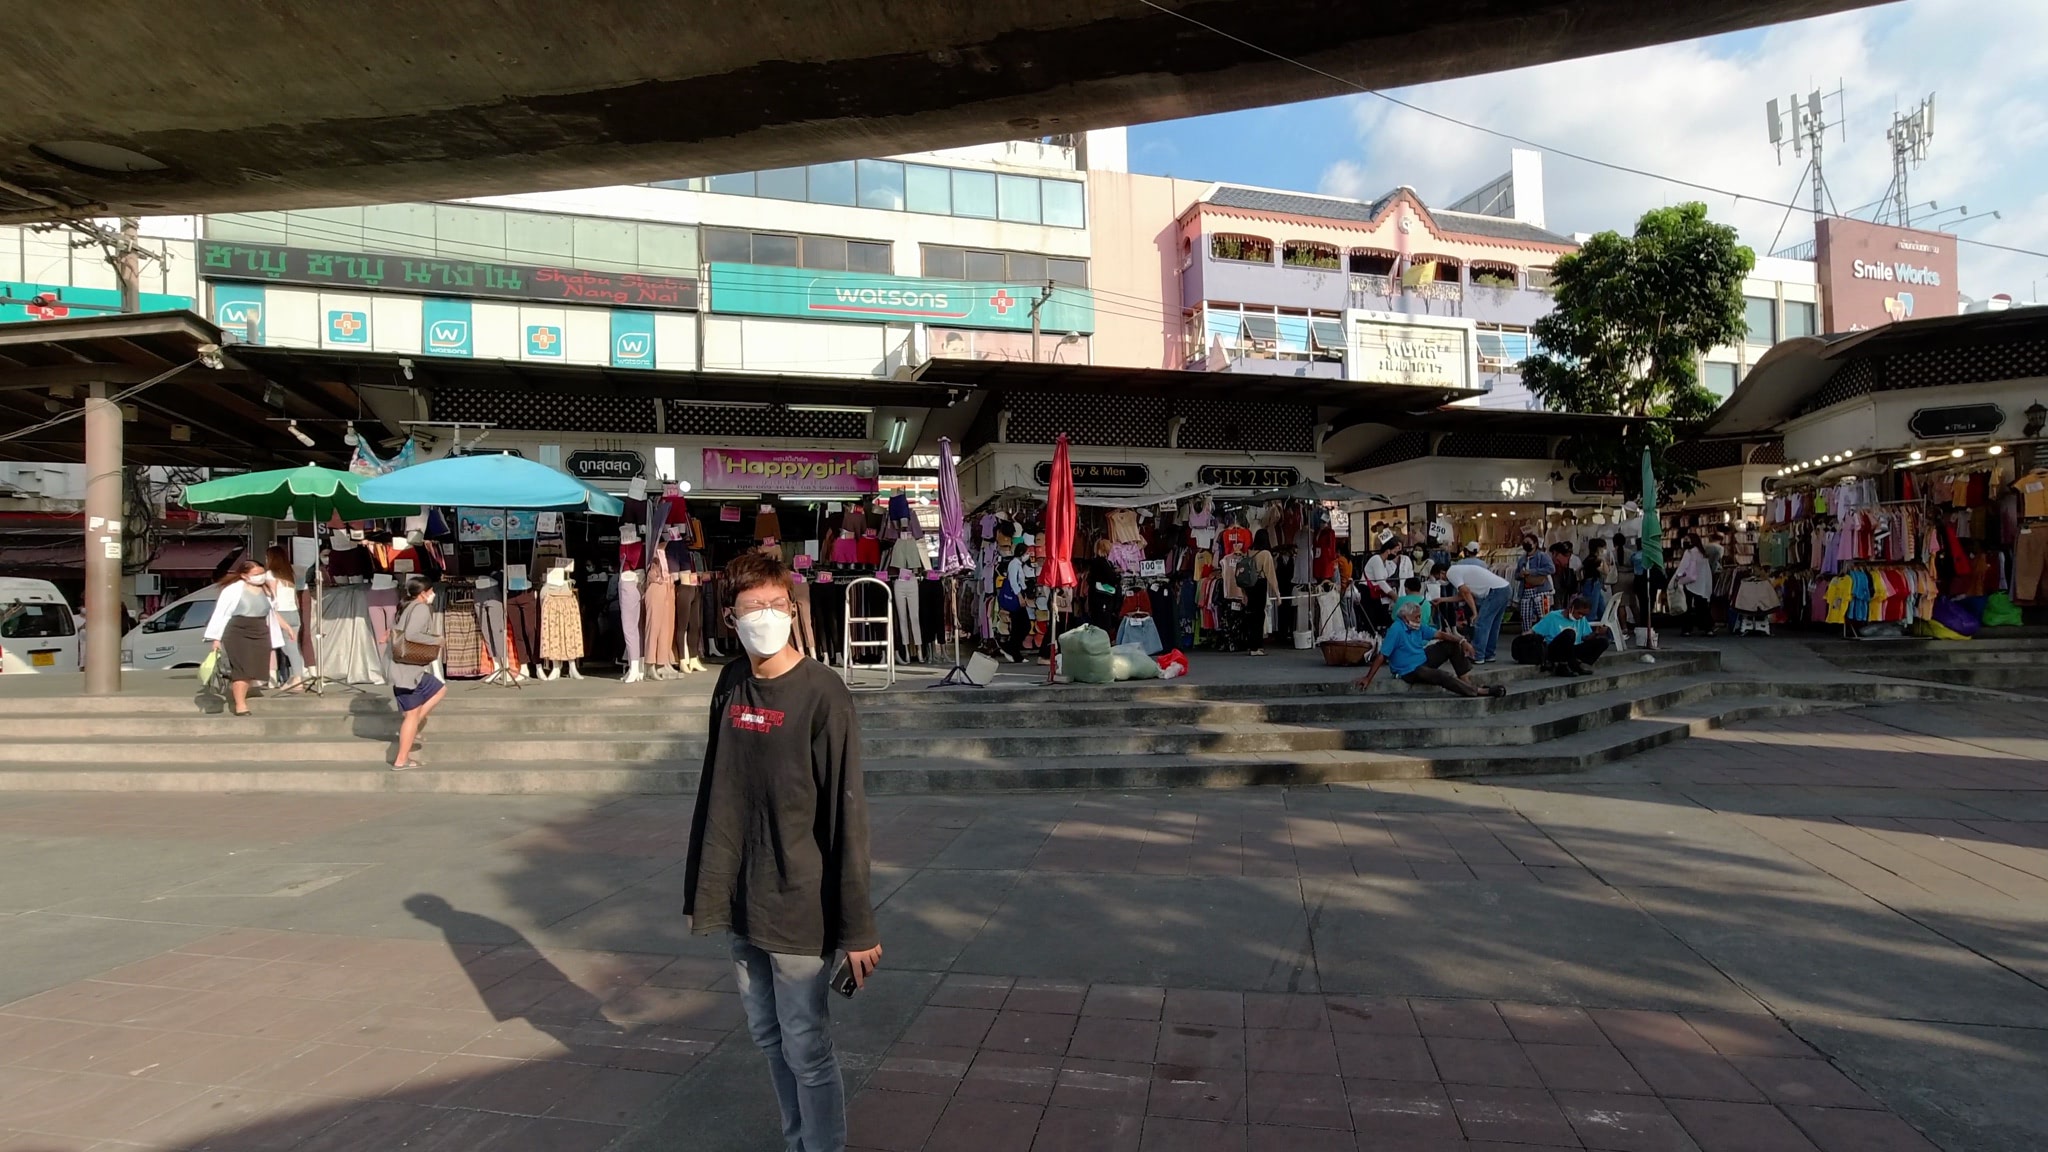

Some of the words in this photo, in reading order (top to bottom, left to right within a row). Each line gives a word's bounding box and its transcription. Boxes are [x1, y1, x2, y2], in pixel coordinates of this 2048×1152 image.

[205, 245, 287, 278] ชาบู
[307, 253, 385, 285] ชาบู
[401, 260, 522, 290] นางใน
[1853, 259, 1893, 281] Smile
[1894, 262, 1940, 287] Works
[535, 267, 611, 287] Shabu
[619, 275, 692, 291] Shabu
[562, 283, 628, 304] Nang
[637, 291, 678, 304] Nai
[835, 286, 948, 309] watsons
[579, 459, 631, 474] ถูกสุดสุด
[1089, 466, 1099, 476] &
[1103, 466, 1126, 477] Men
[1212, 468, 1241, 486] SIS
[1249, 471, 1257, 486] 2
[1263, 470, 1289, 486] SIS
[1430, 523, 1446, 535] 250
[1141, 561, 1155, 571] 100
